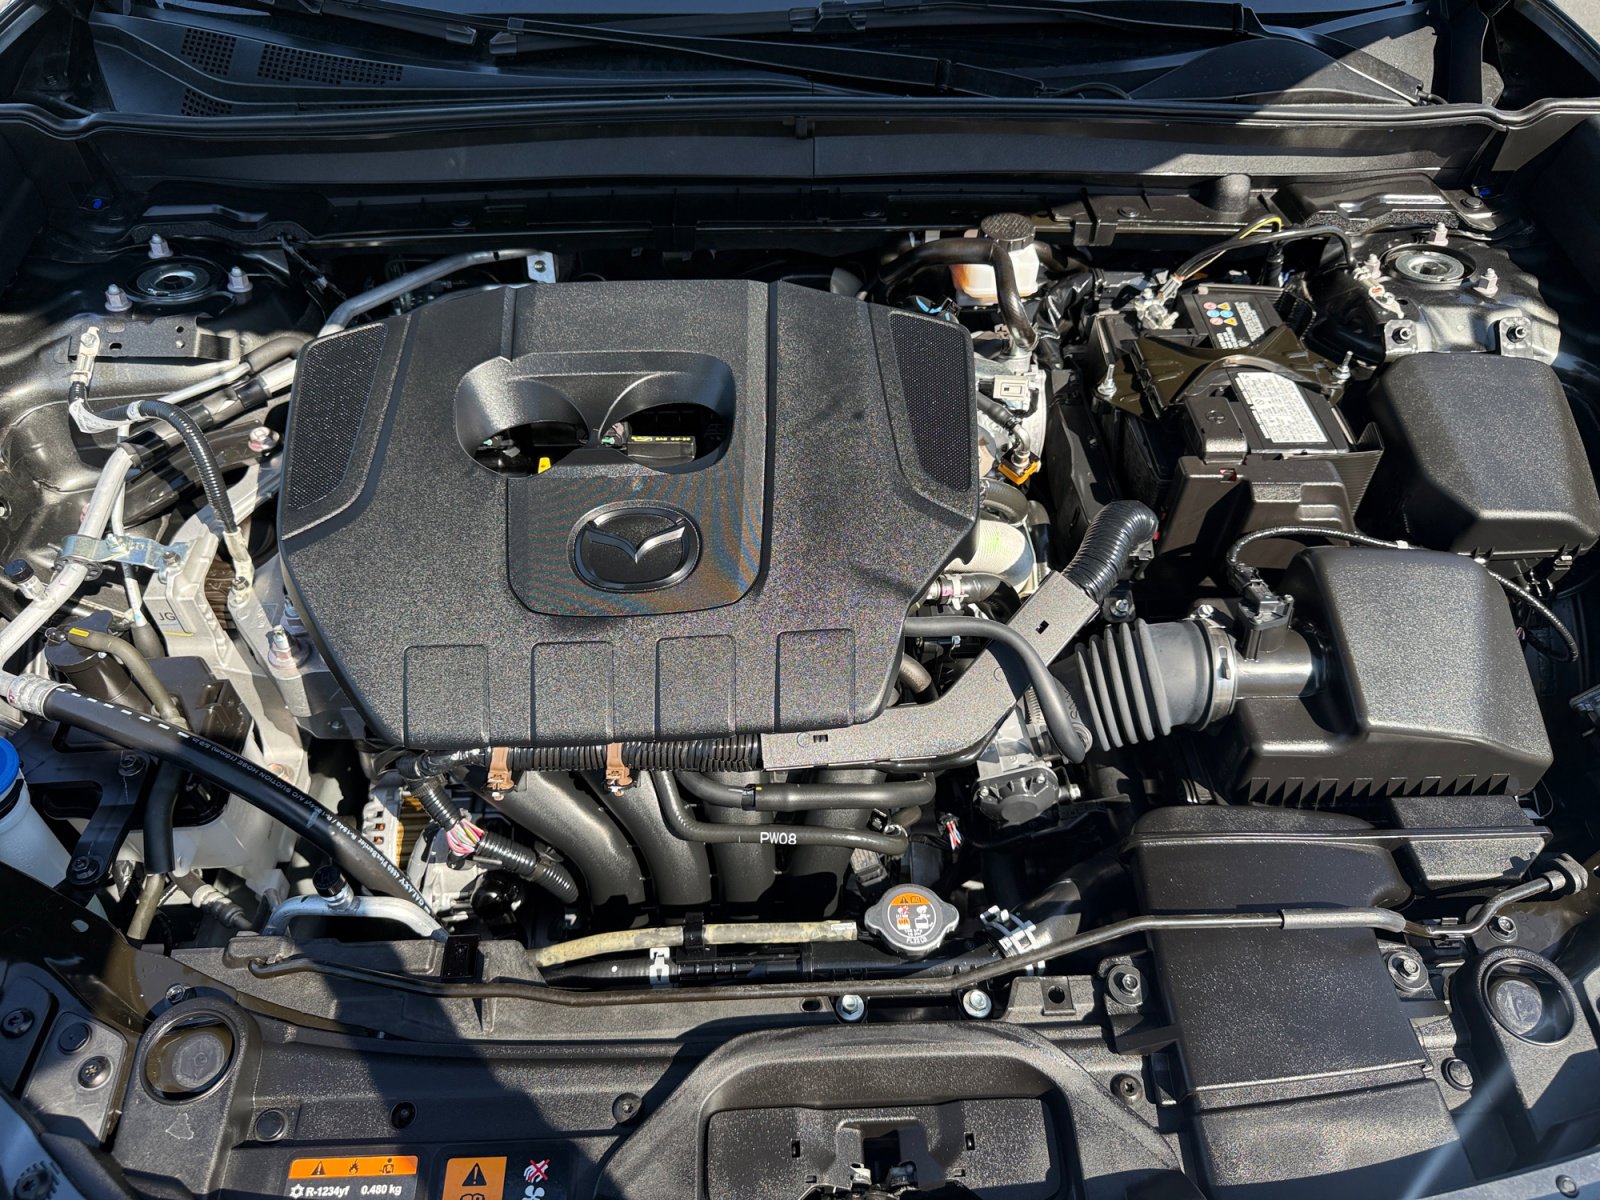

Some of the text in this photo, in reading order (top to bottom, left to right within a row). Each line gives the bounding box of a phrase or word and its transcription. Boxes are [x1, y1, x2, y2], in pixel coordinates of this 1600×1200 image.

[236, 759, 260, 775] HOSE
[258, 770, 293, 794] SUCTION
[760, 831, 797, 845] PW08
[398, 877, 425, 906] GALAXY
[304, 1184, 402, 1198] R-1234yf 0.480 kg
